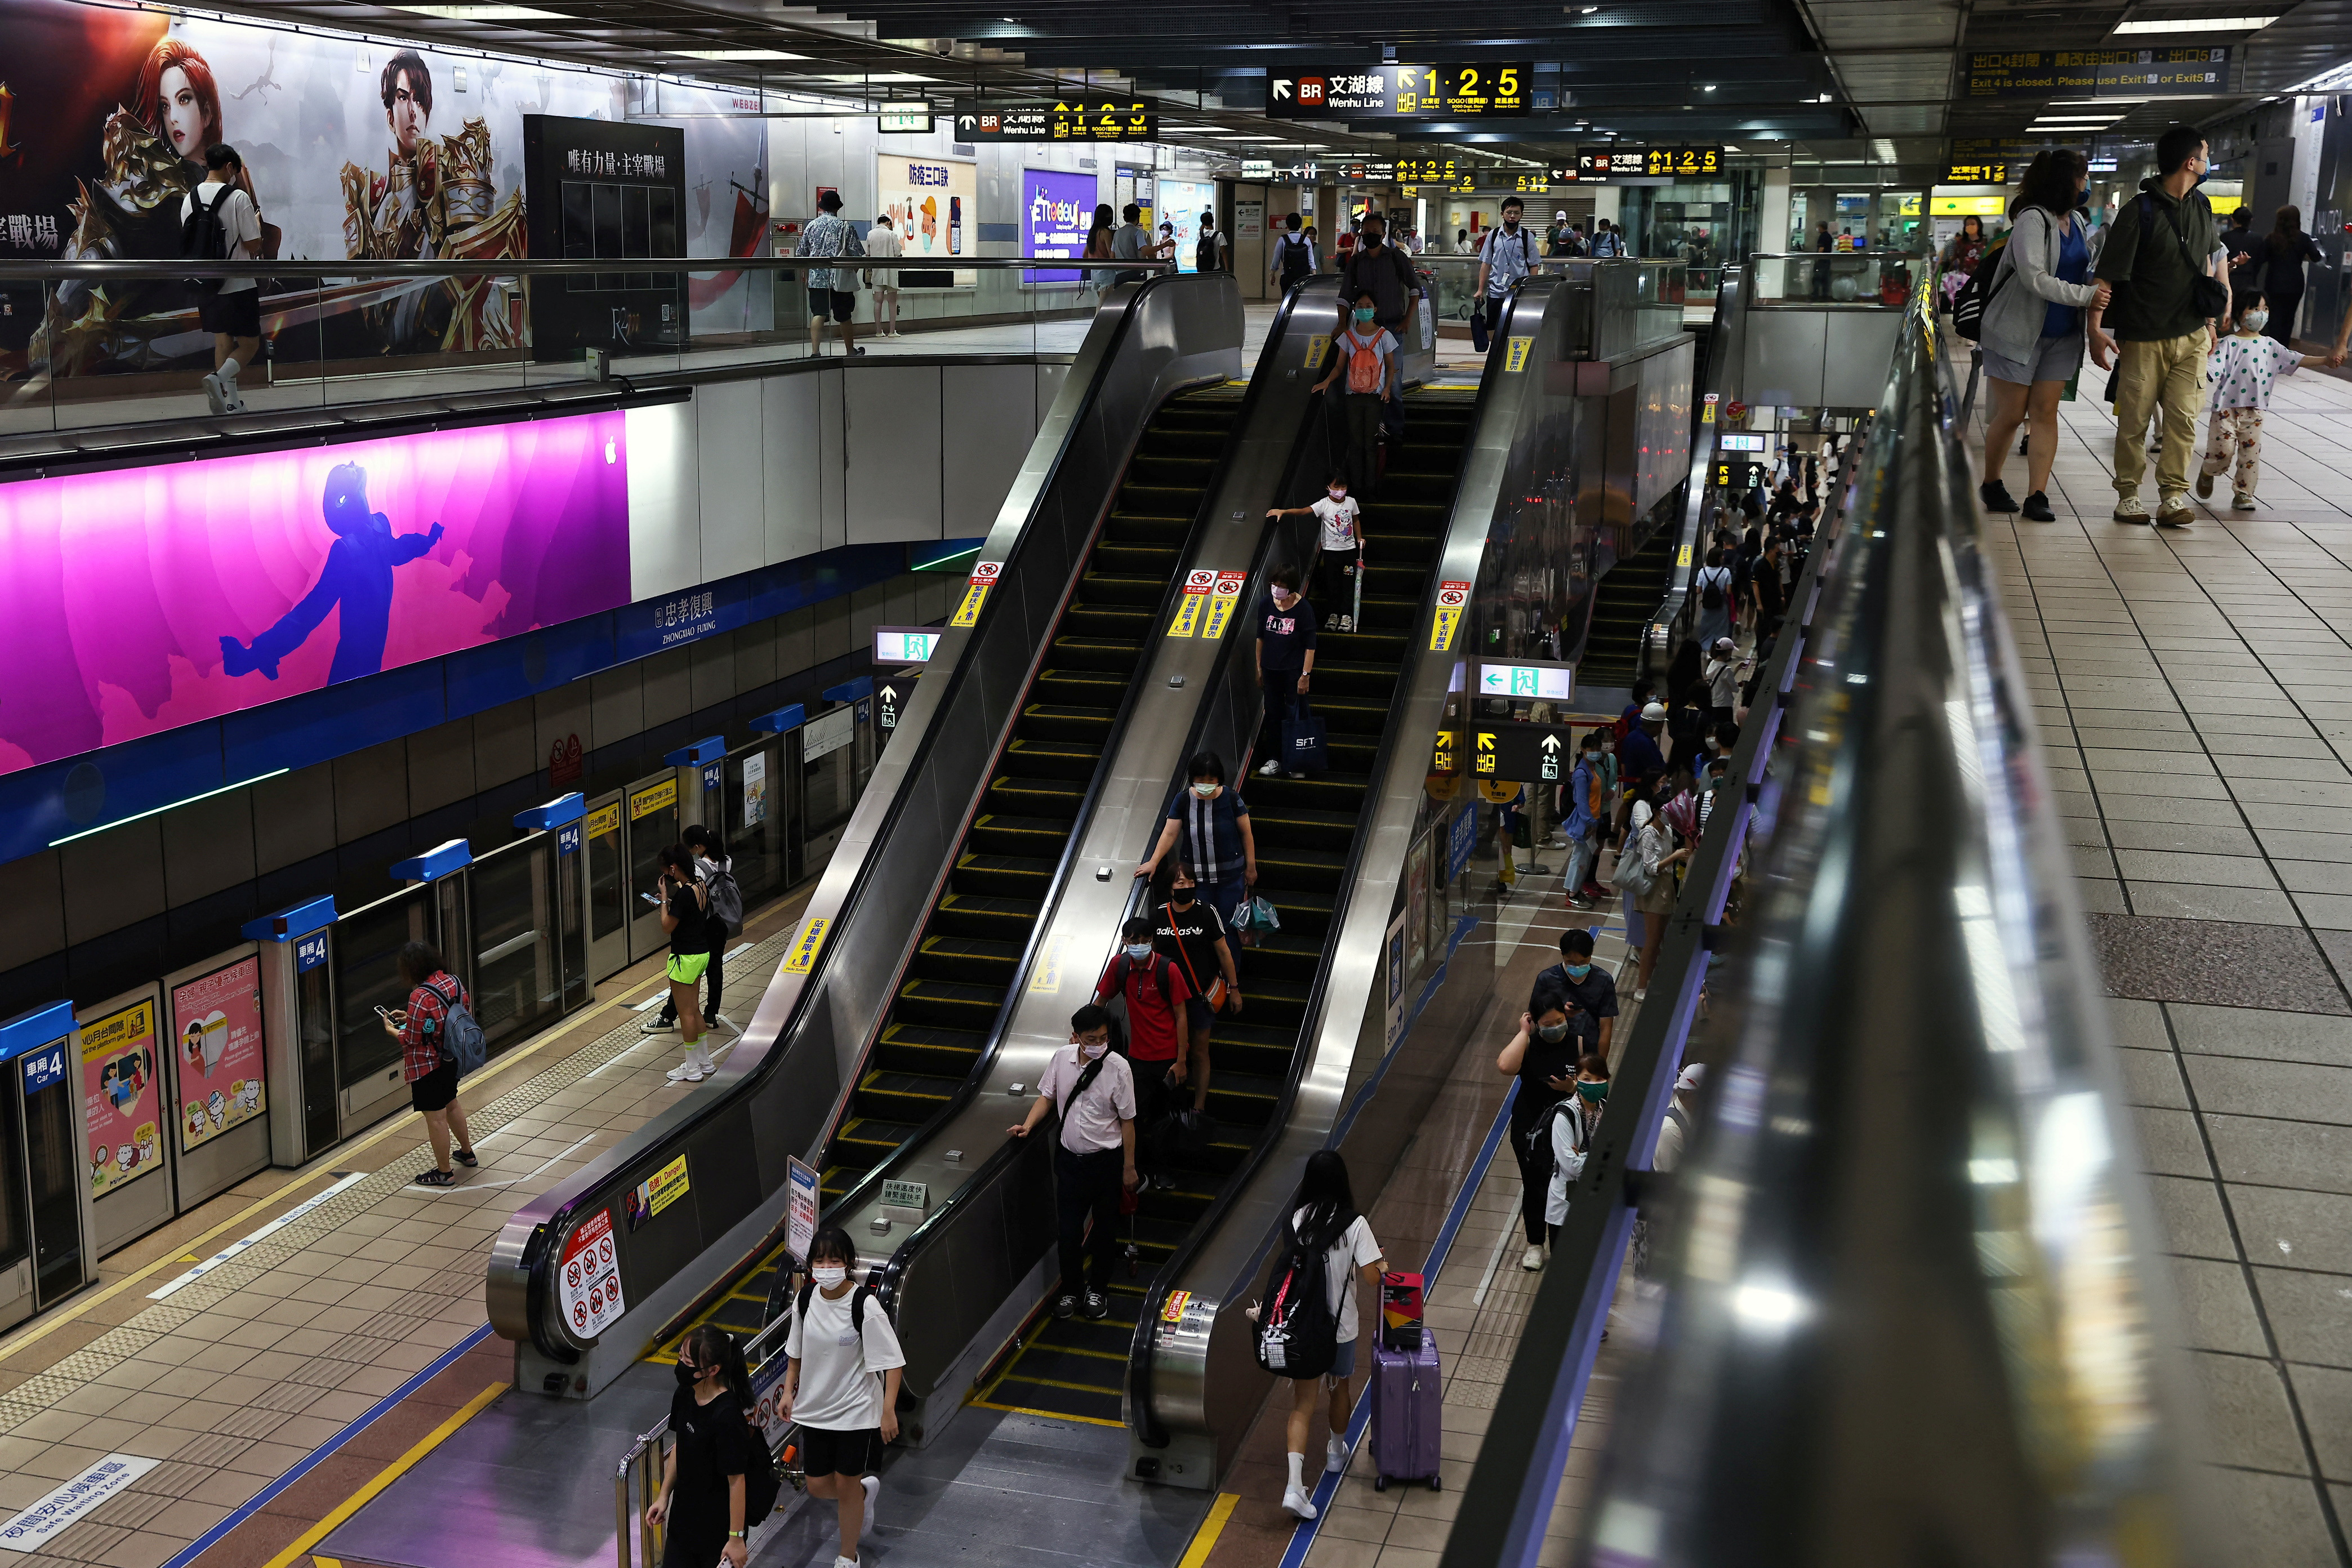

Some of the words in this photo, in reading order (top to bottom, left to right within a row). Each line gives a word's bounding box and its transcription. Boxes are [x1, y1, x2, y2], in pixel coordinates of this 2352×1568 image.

[1329, 75, 1384, 95] 文湖線
[1424, 69, 1437, 96] 1
[1458, 68, 1478, 96] 2
[1498, 69, 1518, 96] 5
[1971, 78, 1992, 87] Exit
[2003, 78, 2012, 87] is
[2015, 78, 2054, 87] closed.
[2057, 77, 2095, 86] Please
[2097, 77, 2117, 85] use
[2161, 75, 2173, 83] or
[1300, 84, 1321, 98] BR
[1328, 97, 1362, 108] Wenhu
[1364, 97, 1384, 108] Line
[1397, 92, 1416, 113] 出口
[981, 115, 997, 127] BR
[1073, 104, 1084, 125] 1
[1100, 103, 1115, 125] 2
[1130, 104, 1145, 125] 5
[1003, 126, 1028, 135] Wenhu
[1030, 126, 1045, 134] Line
[1611, 154, 1642, 165] 文湖線
[1664, 152, 1672, 165] 1
[1683, 151, 1694, 166] 2
[1704, 151, 1716, 165] 5
[1410, 161, 1416, 173] 1
[1426, 161, 1436, 173] 2
[1445, 161, 1455, 174] 5
[1982, 166, 1991, 180] 1
[909, 164, 948, 187] 防疫三口訣
[1463, 176, 1471, 186] 2
[1517, 176, 1525, 186] 5
[1530, 176, 1536, 185] 1
[665, 591, 713, 627] 忠孝復興
[663, 627, 695, 644] ZHONGXIAO
[697, 620, 716, 634] FUXING
[865, 702, 869, 716] 4
[1296, 737, 1315, 746] SFT
[705, 769, 714, 780] 車廂
[714, 767, 719, 782] 4
[560, 831, 571, 844] 車廂
[572, 828, 578, 845] 4
[801, 920, 825, 951] 站穩踏階
[1156, 926, 1192, 936] adidas
[299, 942, 314, 957] 車廂
[316, 938, 325, 958] 4
[97, 1037, 116, 1049] platform
[27, 1057, 47, 1077] 車廂
[50, 1051, 63, 1075] 4
[37, 1073, 49, 1084] Car
[664, 1161, 683, 1180] Danger!
[886, 1183, 923, 1193] 扶梯速度快
[885, 1190, 921, 1201] 請緊握扶手
[277, 1203, 316, 1223] Waiting
[317, 1191, 335, 1203] Line
[1177, 1465, 1182, 1473] 3
[0, 1462, 127, 1539] 夜間安心候車區
[36, 1517, 64, 1534] Safe
[61, 1491, 105, 1516] Waiting
[100, 1472, 130, 1490] Zone
